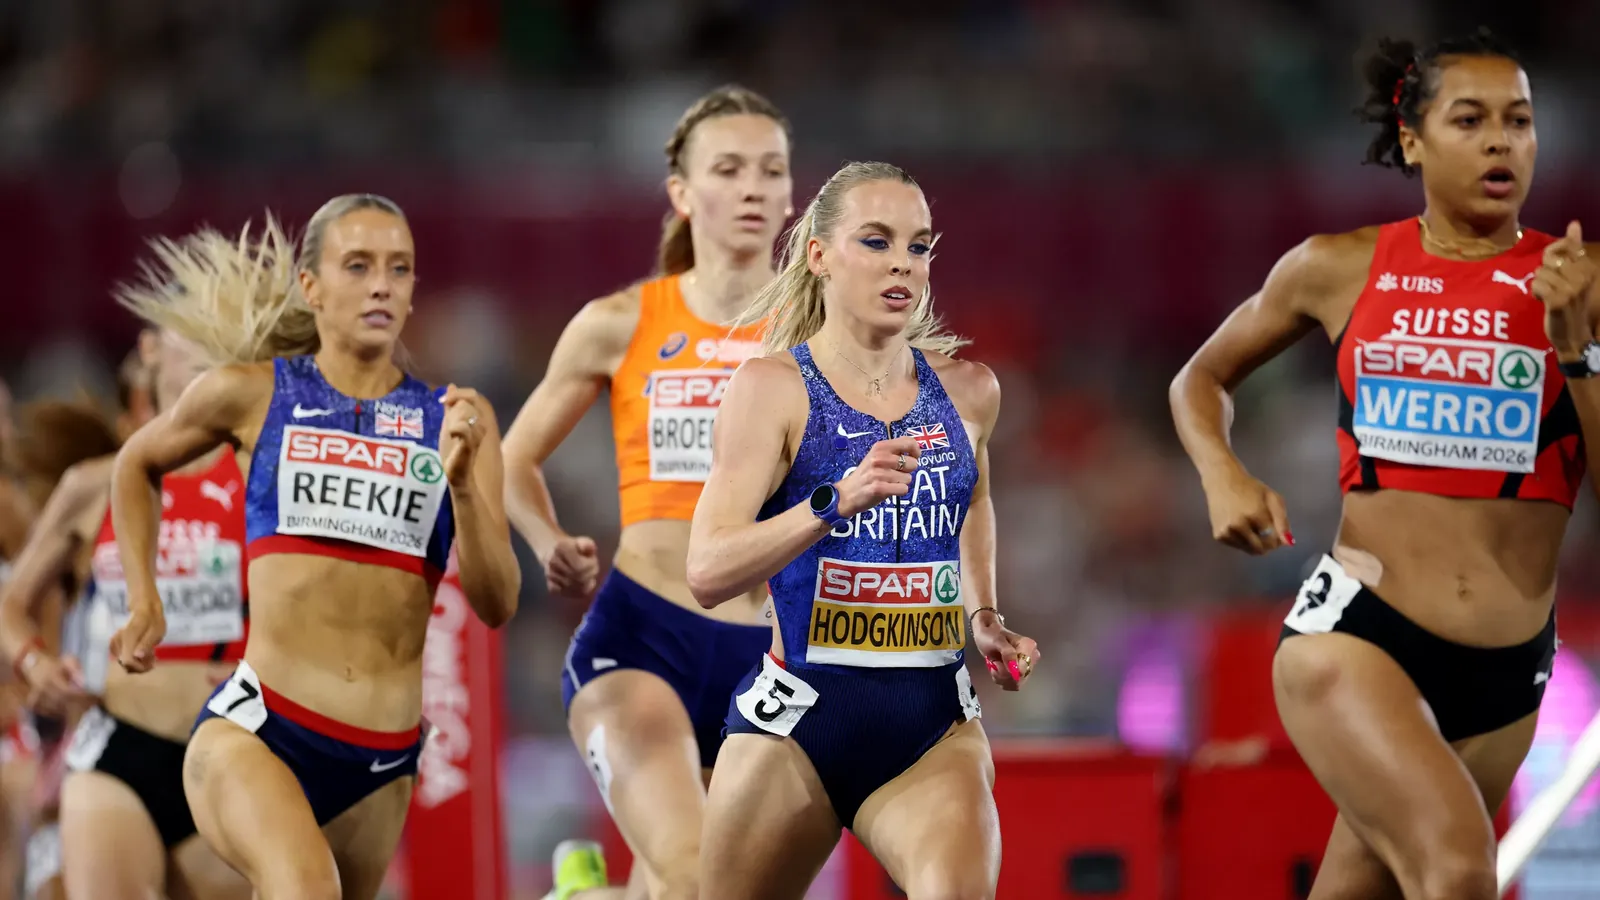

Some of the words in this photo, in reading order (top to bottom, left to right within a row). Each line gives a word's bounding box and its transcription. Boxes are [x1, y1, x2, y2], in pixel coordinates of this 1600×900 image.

[1401, 276, 1444, 294] UBS
[1364, 342, 1492, 382] SPAR
[1360, 384, 1532, 438] WERRO
[653, 418, 713, 449] BROE
[1359, 433, 1477, 460] BIRMINGHAM
[1482, 446, 1527, 466] 2026
[290, 435, 405, 473] SPAR
[293, 472, 428, 524] REEKIE
[286, 515, 388, 542] BIRMINGHAM
[390, 530, 425, 550] 2026
[824, 569, 930, 598] SPAR
[813, 607, 961, 648] HODGKINSON
[226, 678, 259, 713] 7
[754, 678, 796, 722] 5
